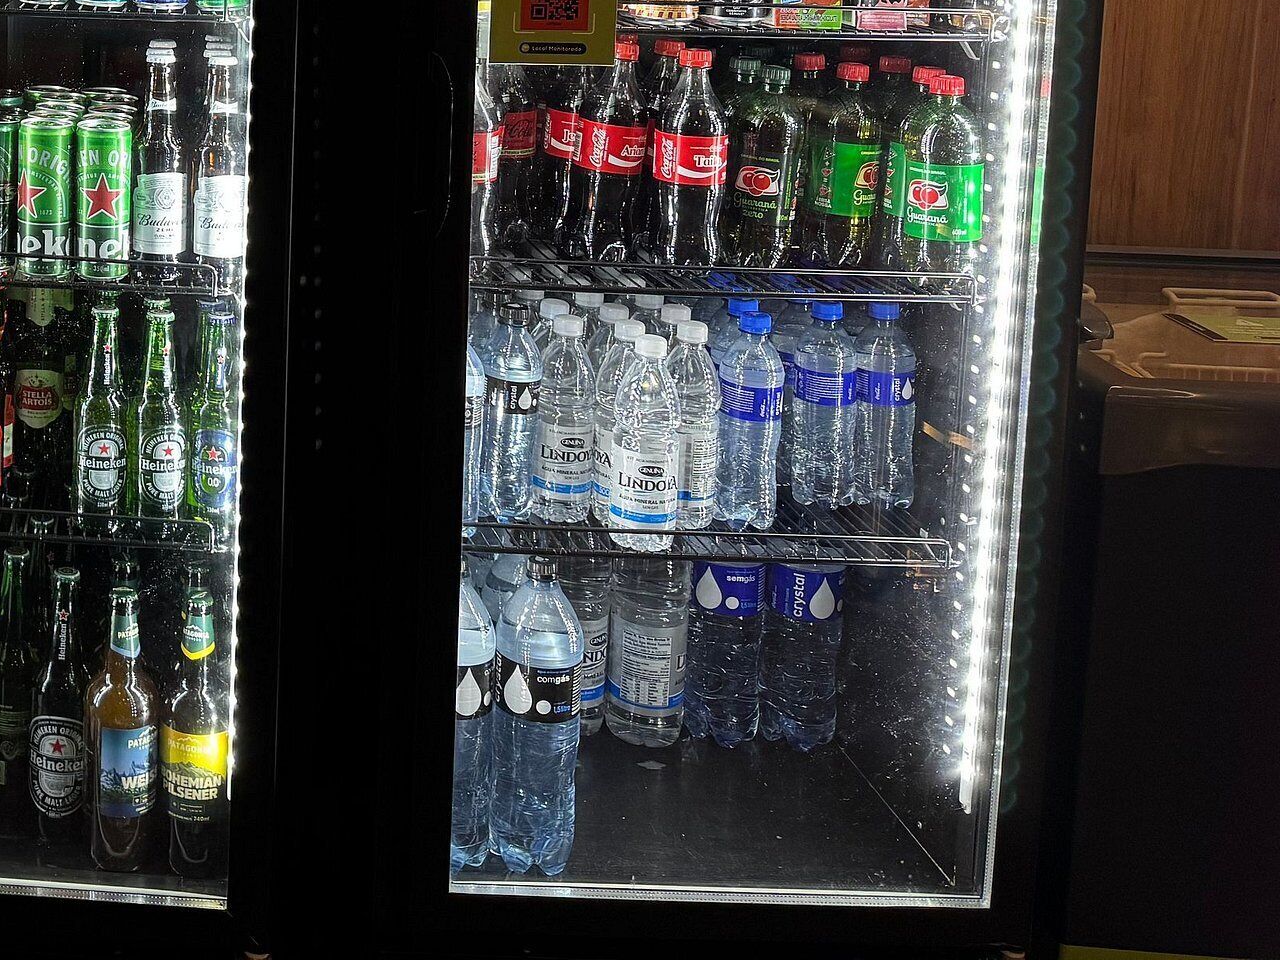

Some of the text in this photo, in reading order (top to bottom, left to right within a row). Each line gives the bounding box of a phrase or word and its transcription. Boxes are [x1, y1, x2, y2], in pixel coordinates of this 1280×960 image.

[589, 126, 607, 168] Coca-Cola
[733, 192, 778, 211] Guaraná
[742, 209, 764, 219] zero
[906, 207, 949, 224] Guaraná
[22, 390, 52, 399] STELLA
[22, 397, 53, 406] ARTOIS
[79, 456, 126, 469] Heineken
[617, 472, 678, 492] LINDOYA
[726, 574, 756, 583] semgás
[793, 572, 806, 617] crystal
[58, 623, 67, 661] Heineken
[536, 674, 570, 685] comgás
